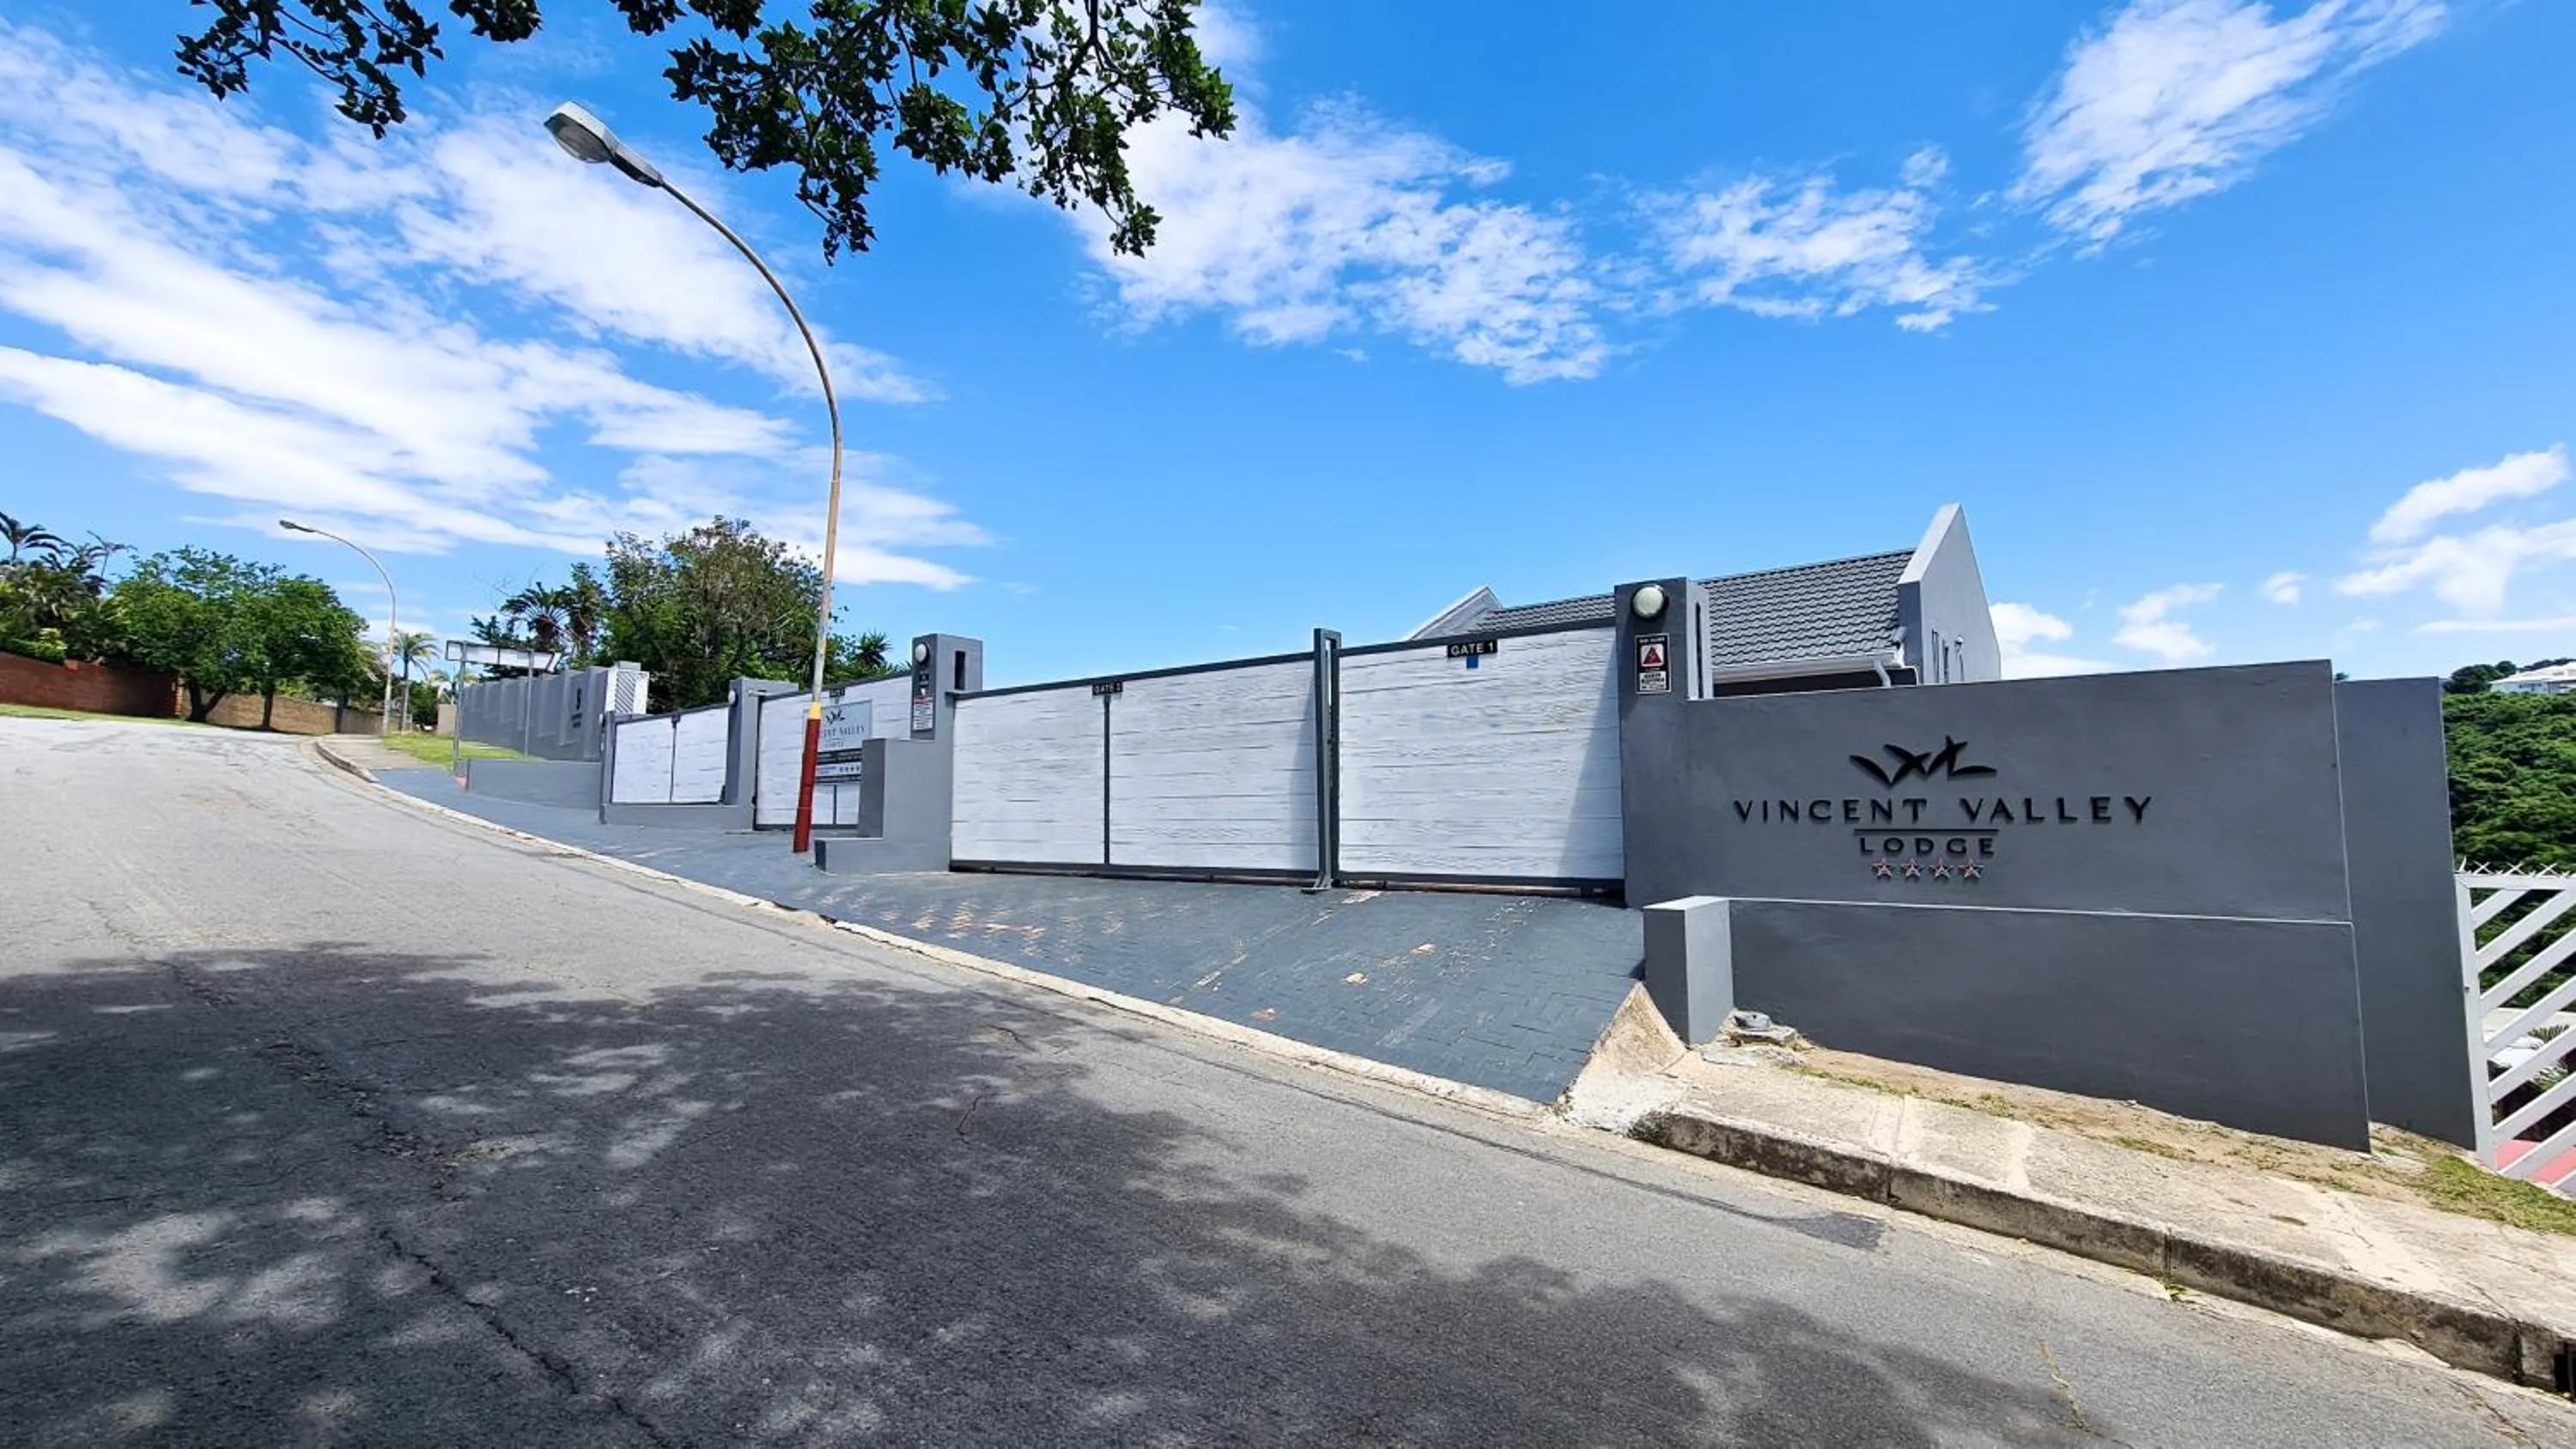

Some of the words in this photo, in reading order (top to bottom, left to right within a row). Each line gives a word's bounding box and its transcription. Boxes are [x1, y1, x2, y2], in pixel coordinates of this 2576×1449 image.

[1451, 643, 1484, 656] GATE
[1488, 641, 1493, 652] 1
[1733, 798, 1928, 824] VINCENT
[1959, 796, 2151, 824] VALLEY
[1859, 837, 1995, 856] LODGE
